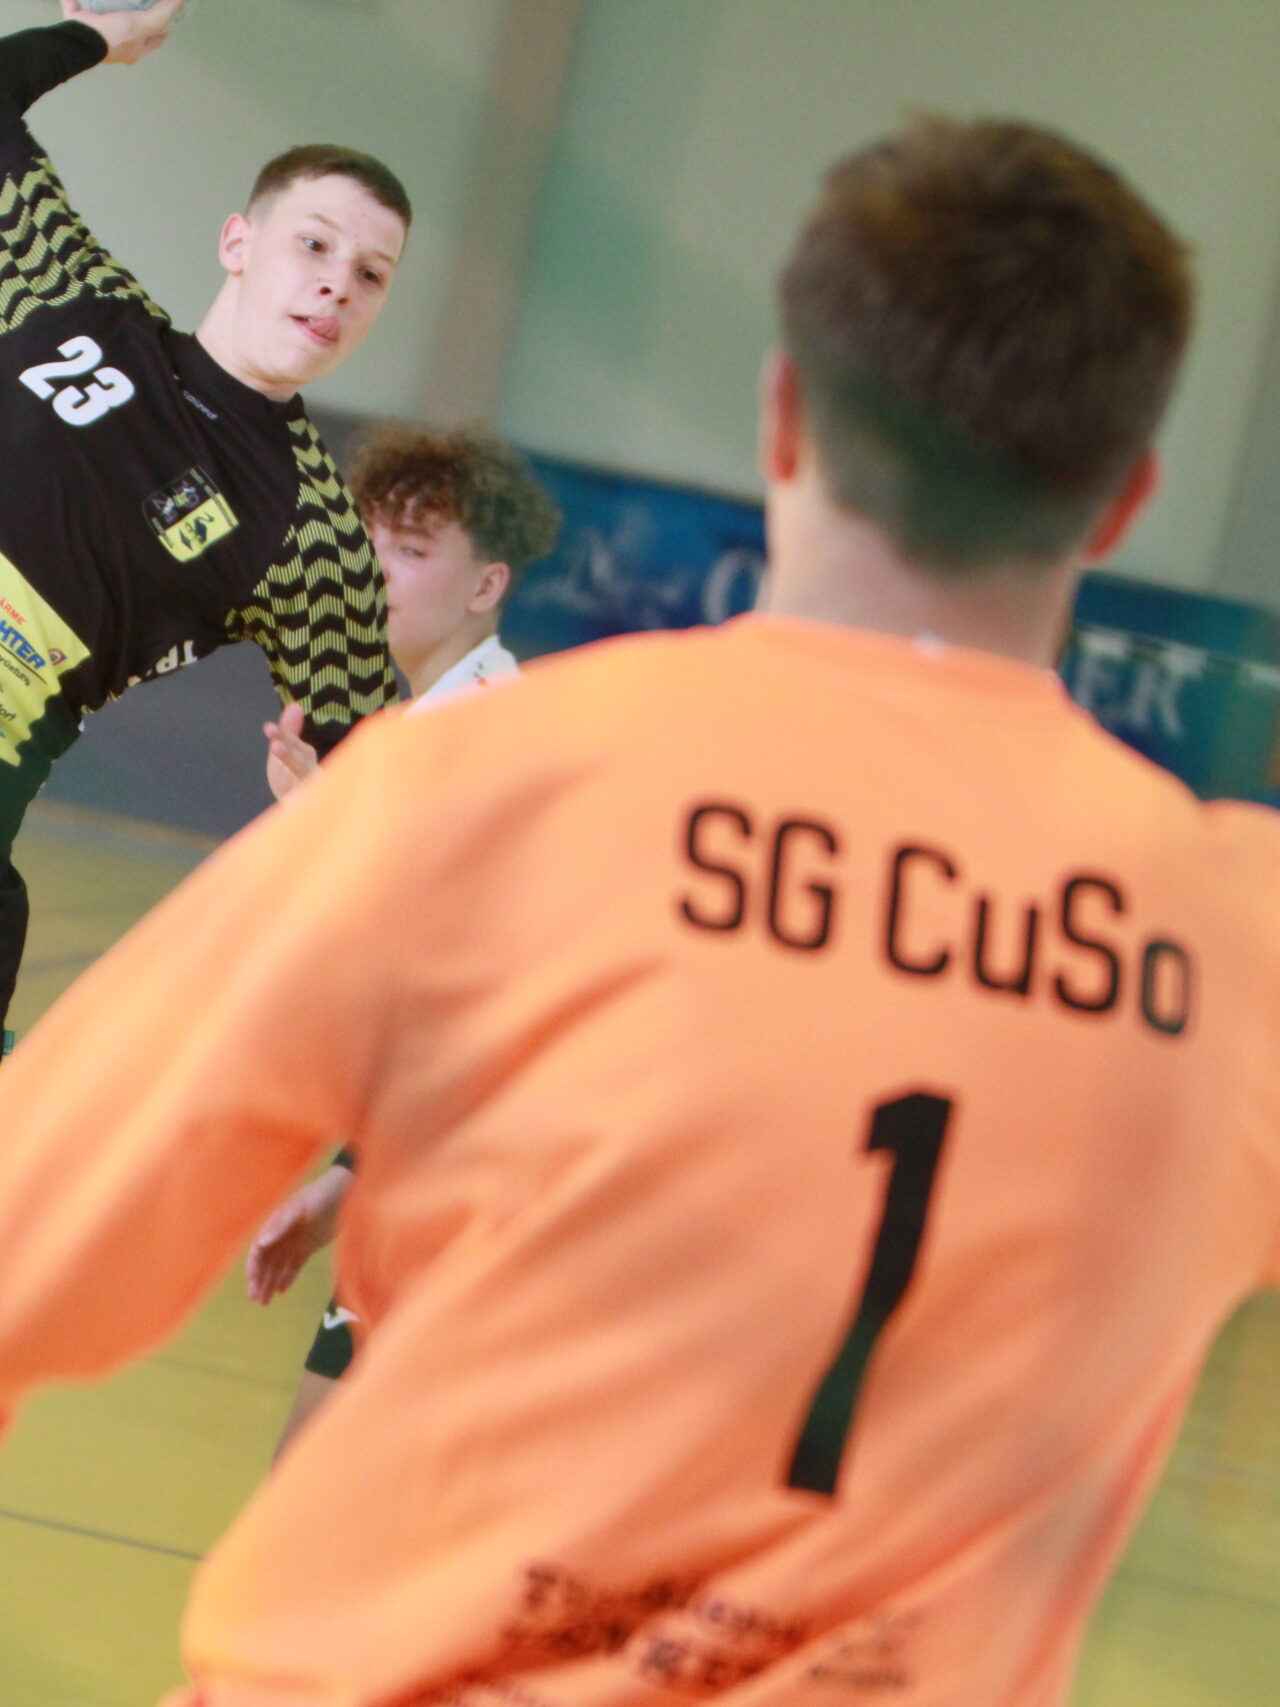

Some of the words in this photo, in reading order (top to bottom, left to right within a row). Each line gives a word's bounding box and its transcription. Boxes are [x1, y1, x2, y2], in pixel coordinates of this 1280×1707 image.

[18, 335, 135, 427] 23
[678, 801, 840, 953] SG
[884, 841, 1194, 1040] CuSo
[784, 1090, 955, 1498] 1
